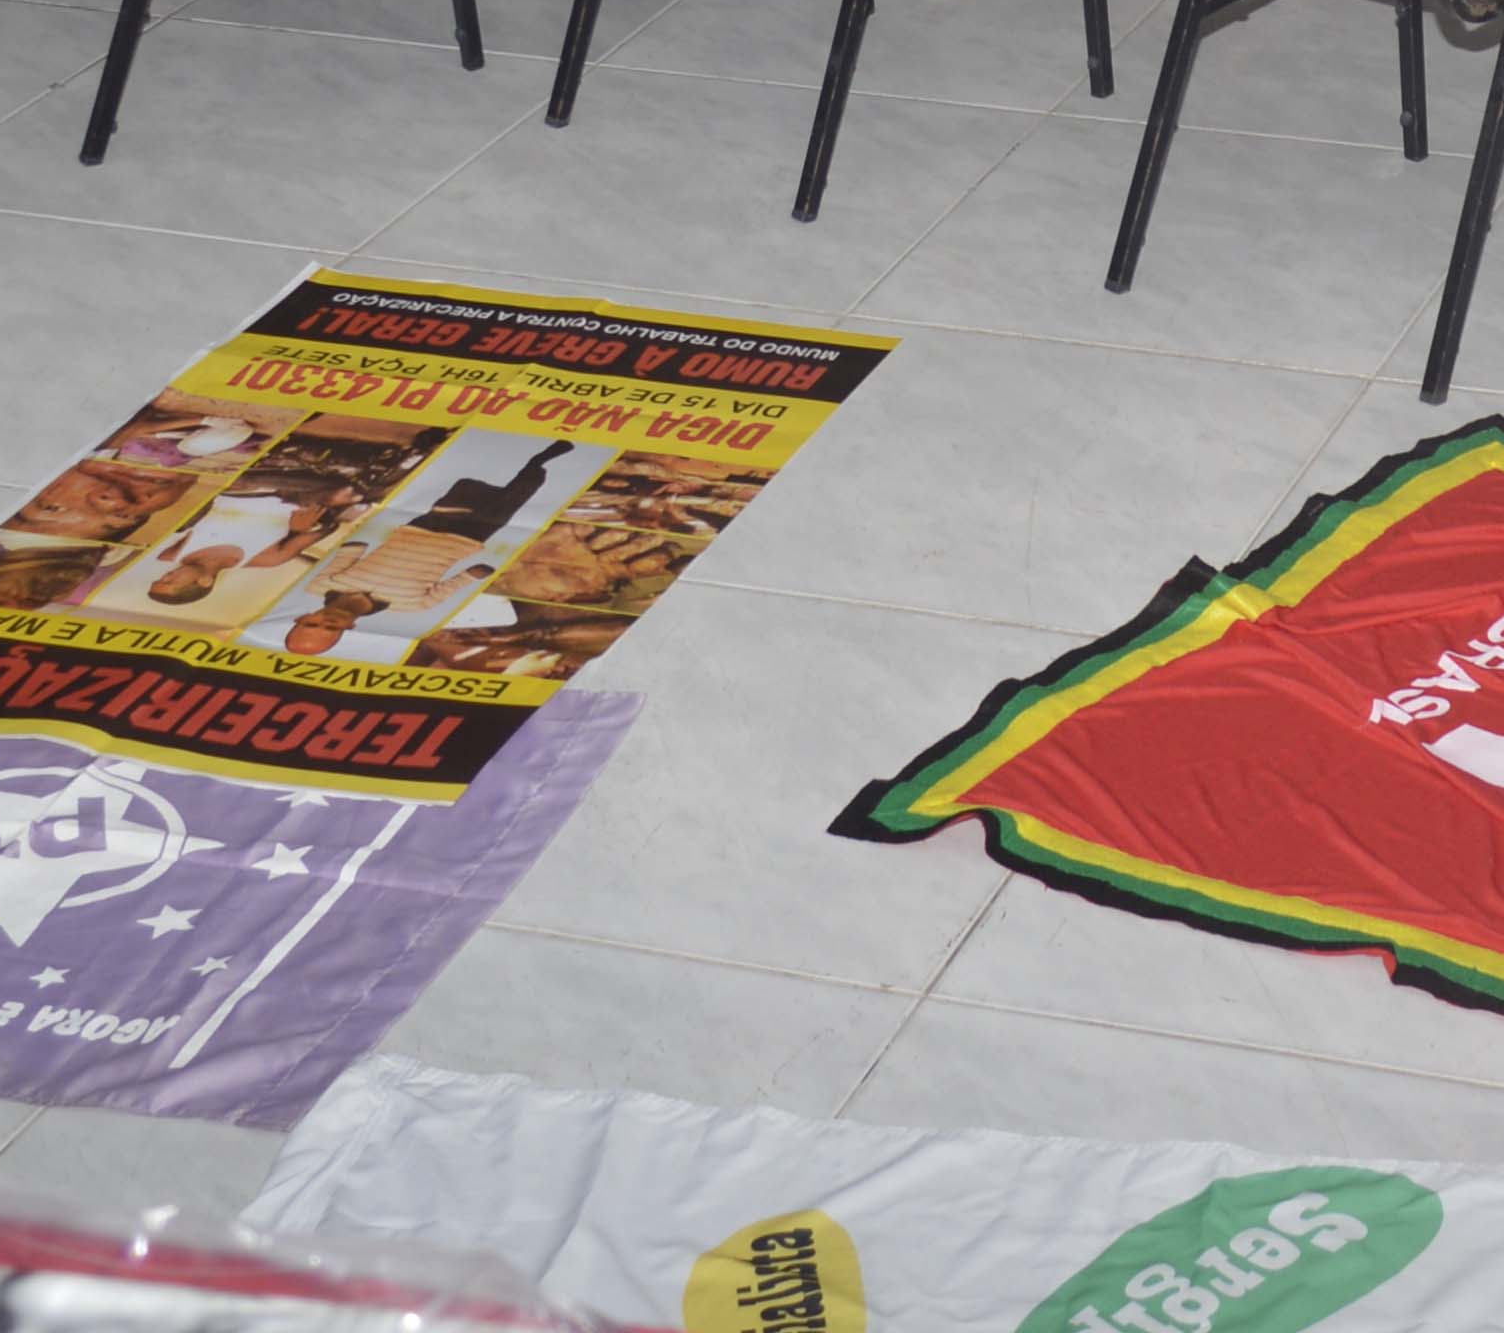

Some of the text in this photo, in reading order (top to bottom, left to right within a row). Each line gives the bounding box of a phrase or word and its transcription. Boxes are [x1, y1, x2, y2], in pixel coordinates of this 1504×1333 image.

[297, 306, 828, 392] RUMO À GREVE GERAL!
[333, 292, 840, 362] MUNDO DO TRABALHO CONTRA A PRECARIZAÇÃO
[262, 344, 790, 420] DIA 15 DE ABRIL, 16H, PÇA SETE
[446, 382, 530, 417] AO
[526, 396, 641, 433] NÃO
[646, 408, 775, 452] DIGA
[49, 620, 88, 641] E
[96, 626, 251, 667] MUTILA
[266, 650, 511, 699] ESCRAVIZA,
[27, 1001, 182, 1046] AGORA
